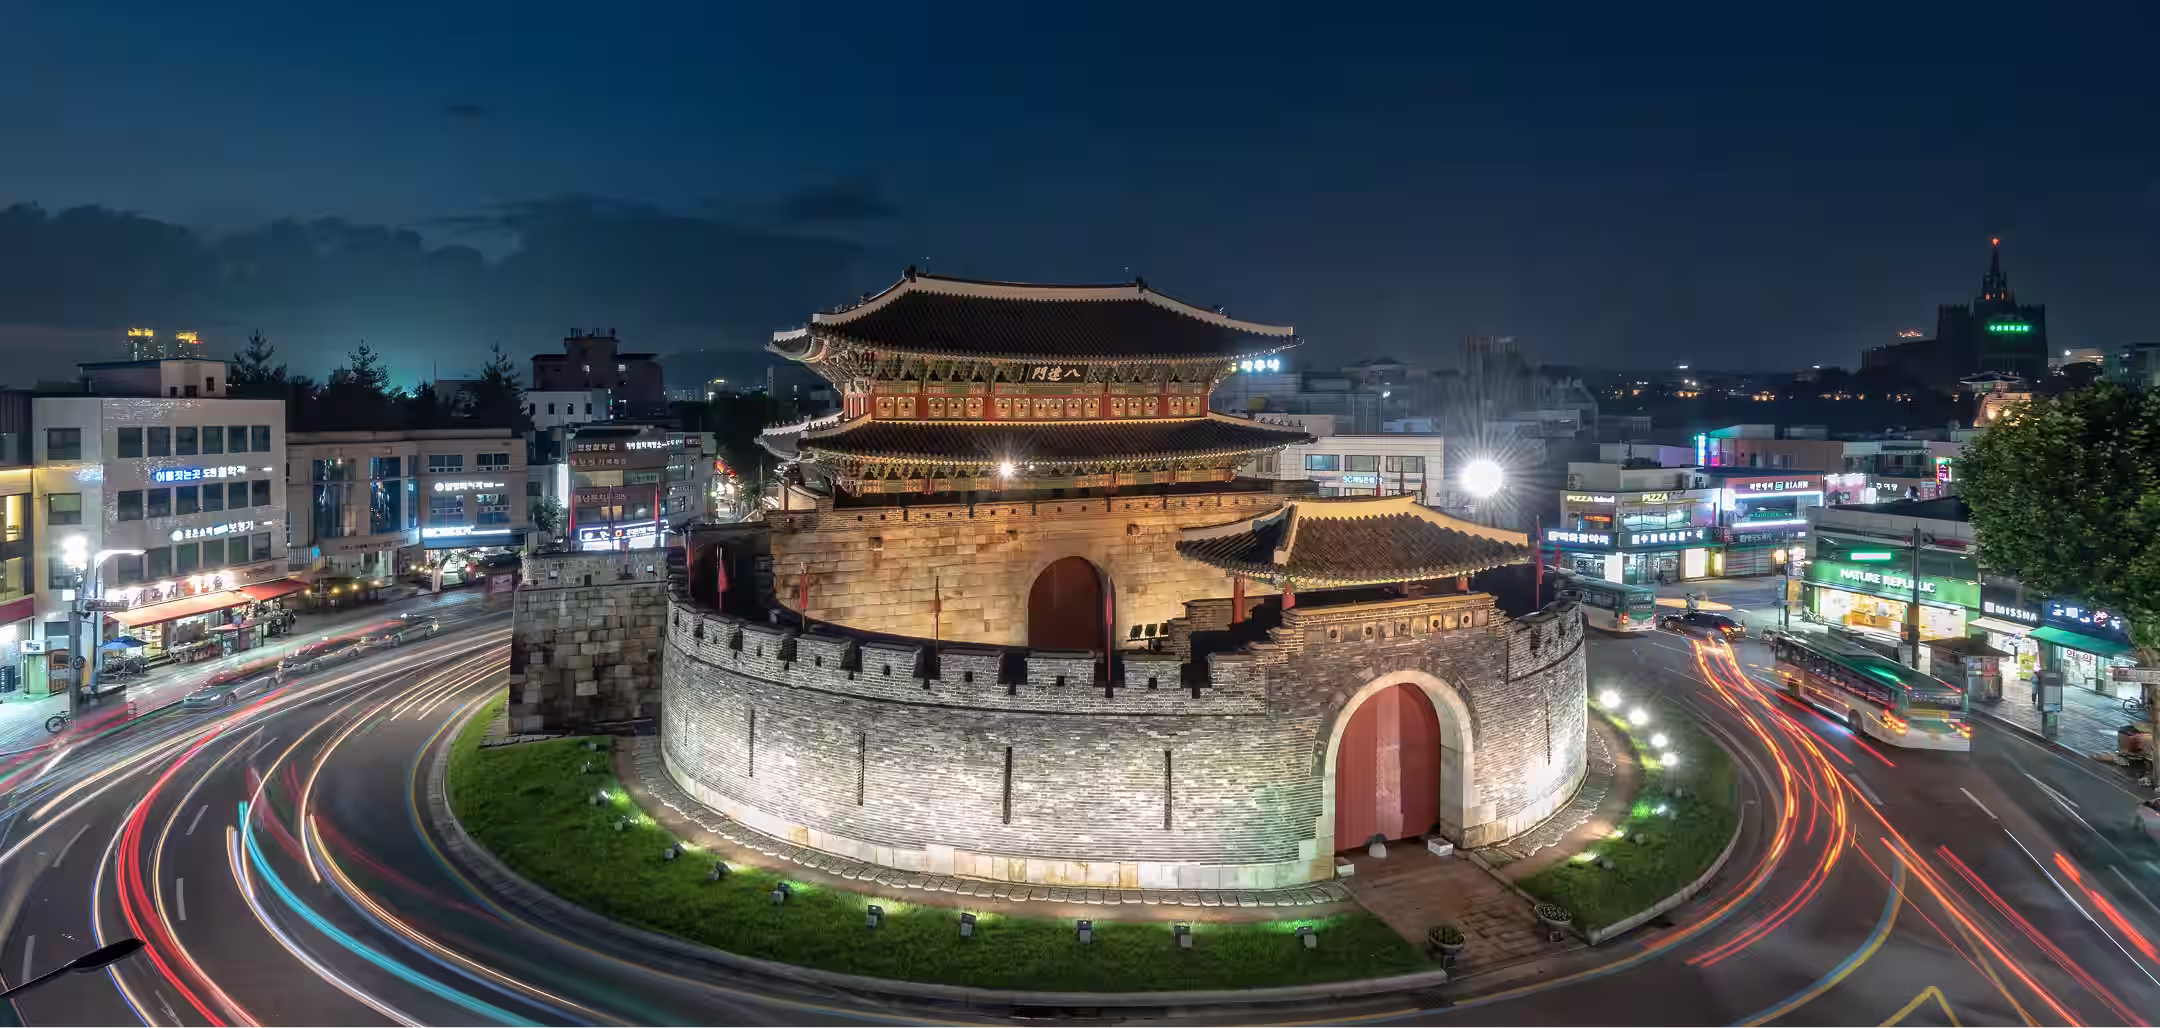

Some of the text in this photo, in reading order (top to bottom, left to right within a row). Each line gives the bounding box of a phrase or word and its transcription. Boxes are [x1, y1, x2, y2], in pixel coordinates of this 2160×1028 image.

[1642, 493, 1668, 502] PIZZA
[229, 521, 253, 533] 보청기
[1841, 569, 1936, 592] NATURE REPULIC
[1996, 605, 2036, 621] MISSHA
